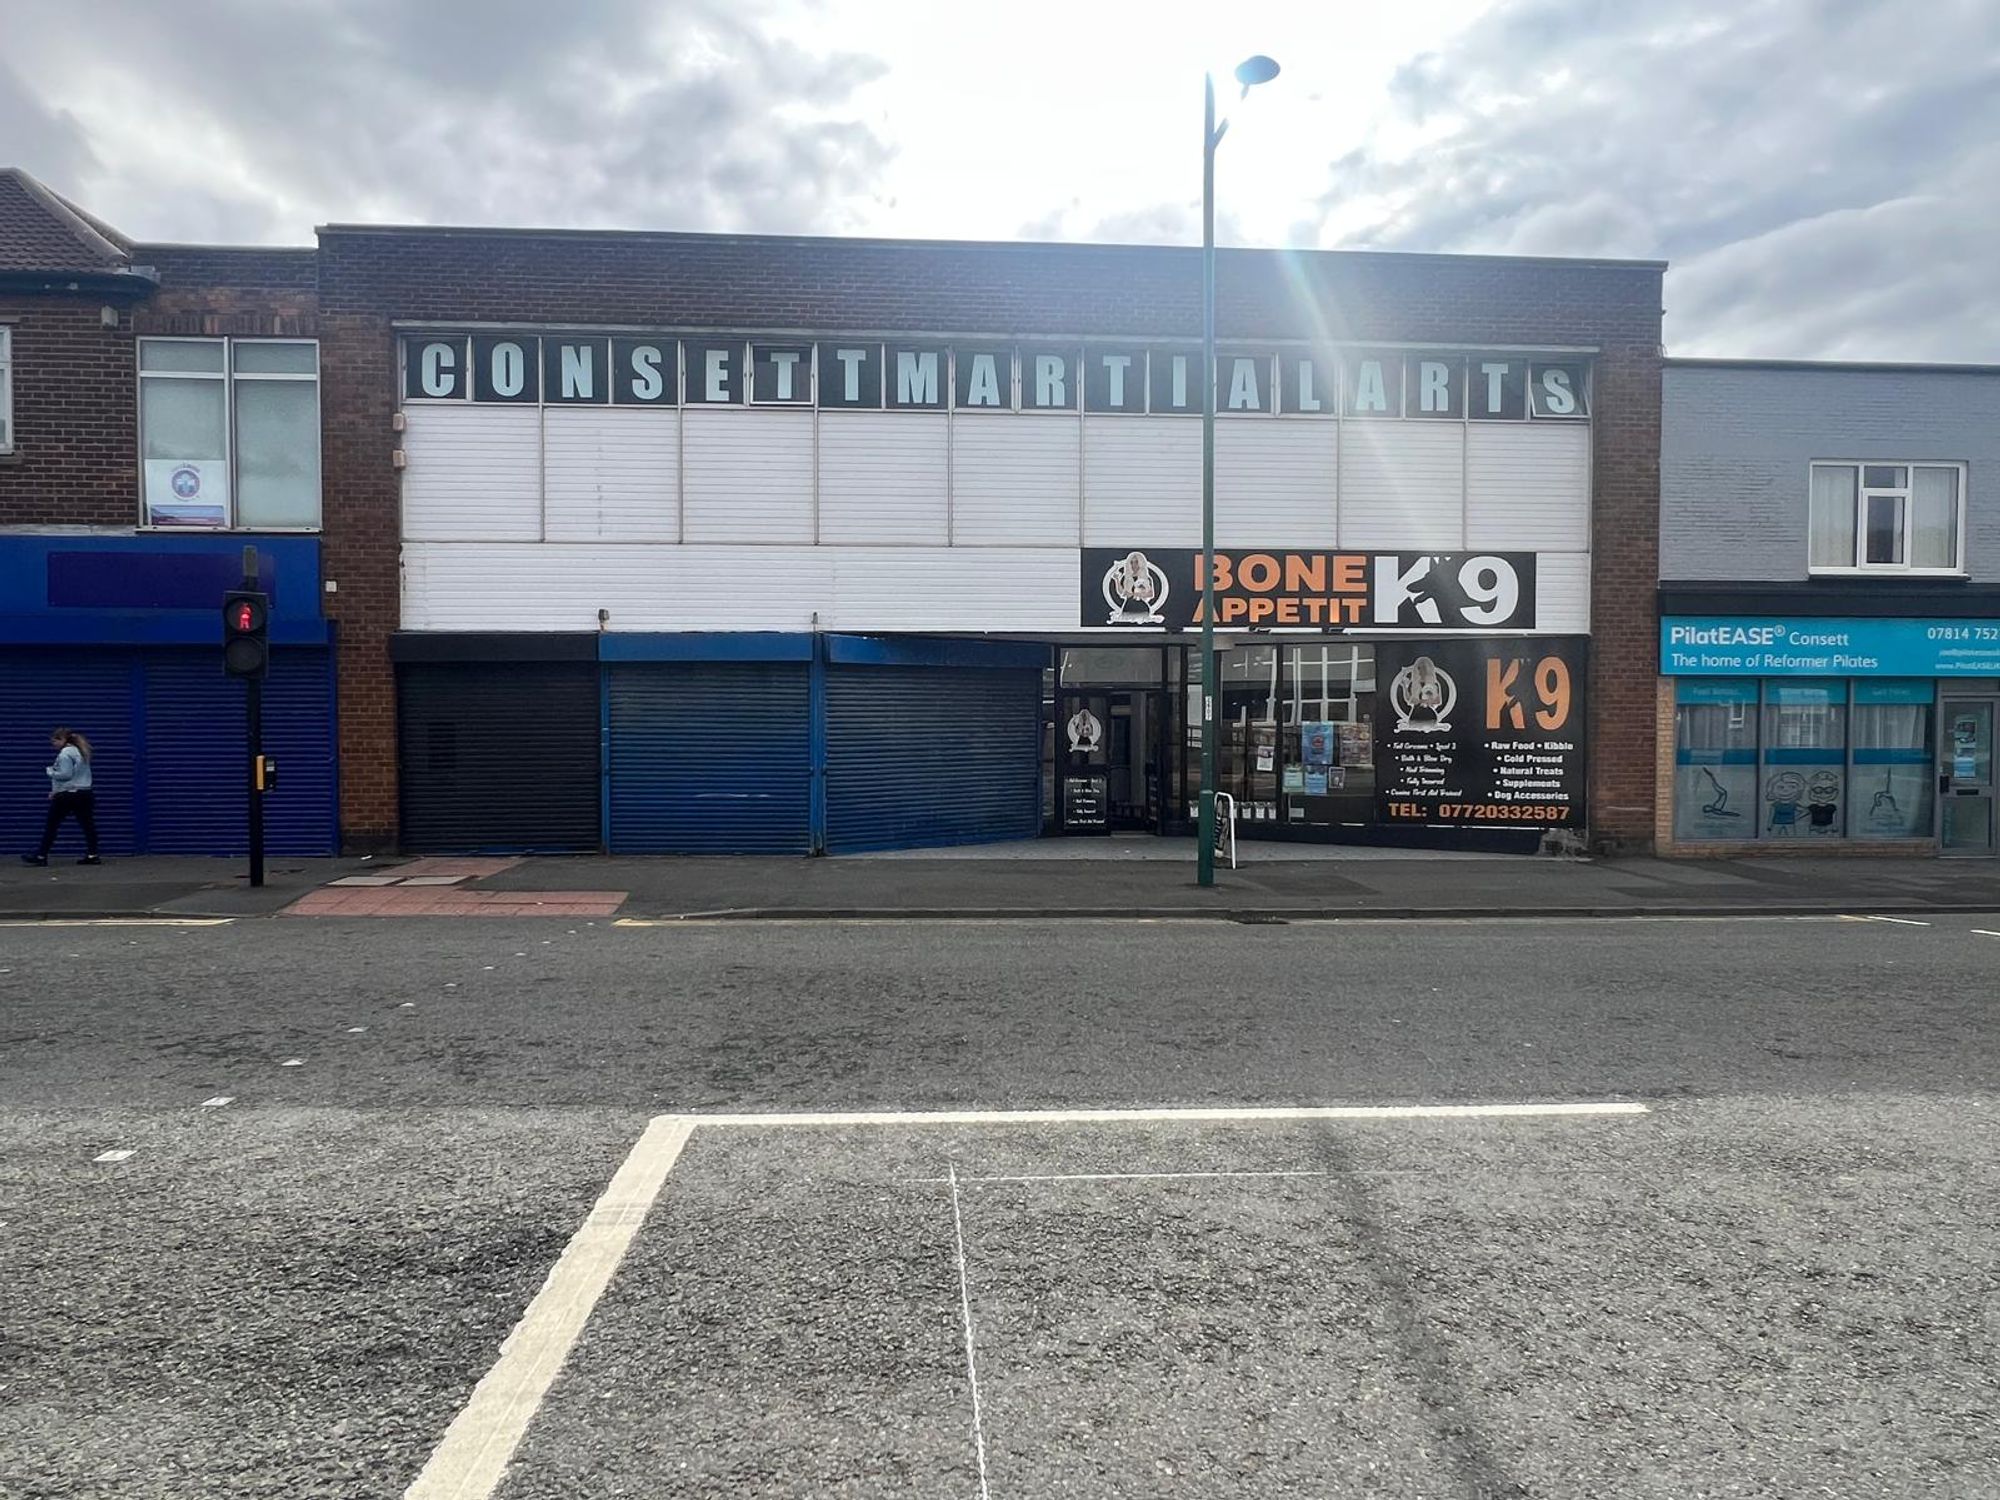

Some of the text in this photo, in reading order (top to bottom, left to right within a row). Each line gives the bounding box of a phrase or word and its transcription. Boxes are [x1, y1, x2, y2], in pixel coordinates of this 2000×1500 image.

[421, 342, 1575, 415] CONSETT MARTIAL ARTS
[1194, 554, 1368, 592] BONE
[1374, 555, 1519, 624] K9
[1191, 597, 1368, 623] APPETIT
[1789, 632, 1849, 646] Consett
[1927, 627, 2000, 640] 07814 752
[1672, 653, 1878, 668] The home of Reformer Pilates
[1486, 656, 1571, 730] K9
[1491, 741, 1574, 750] Raw Food Kibble
[1503, 754, 1563, 763] Cold Pressed
[1500, 766, 1563, 775] Natural Treats
[1502, 779, 1561, 788] Supplements
[1494, 791, 1569, 801] Dog Accessories
[1388, 803, 1570, 820] TEL: 07720332587
